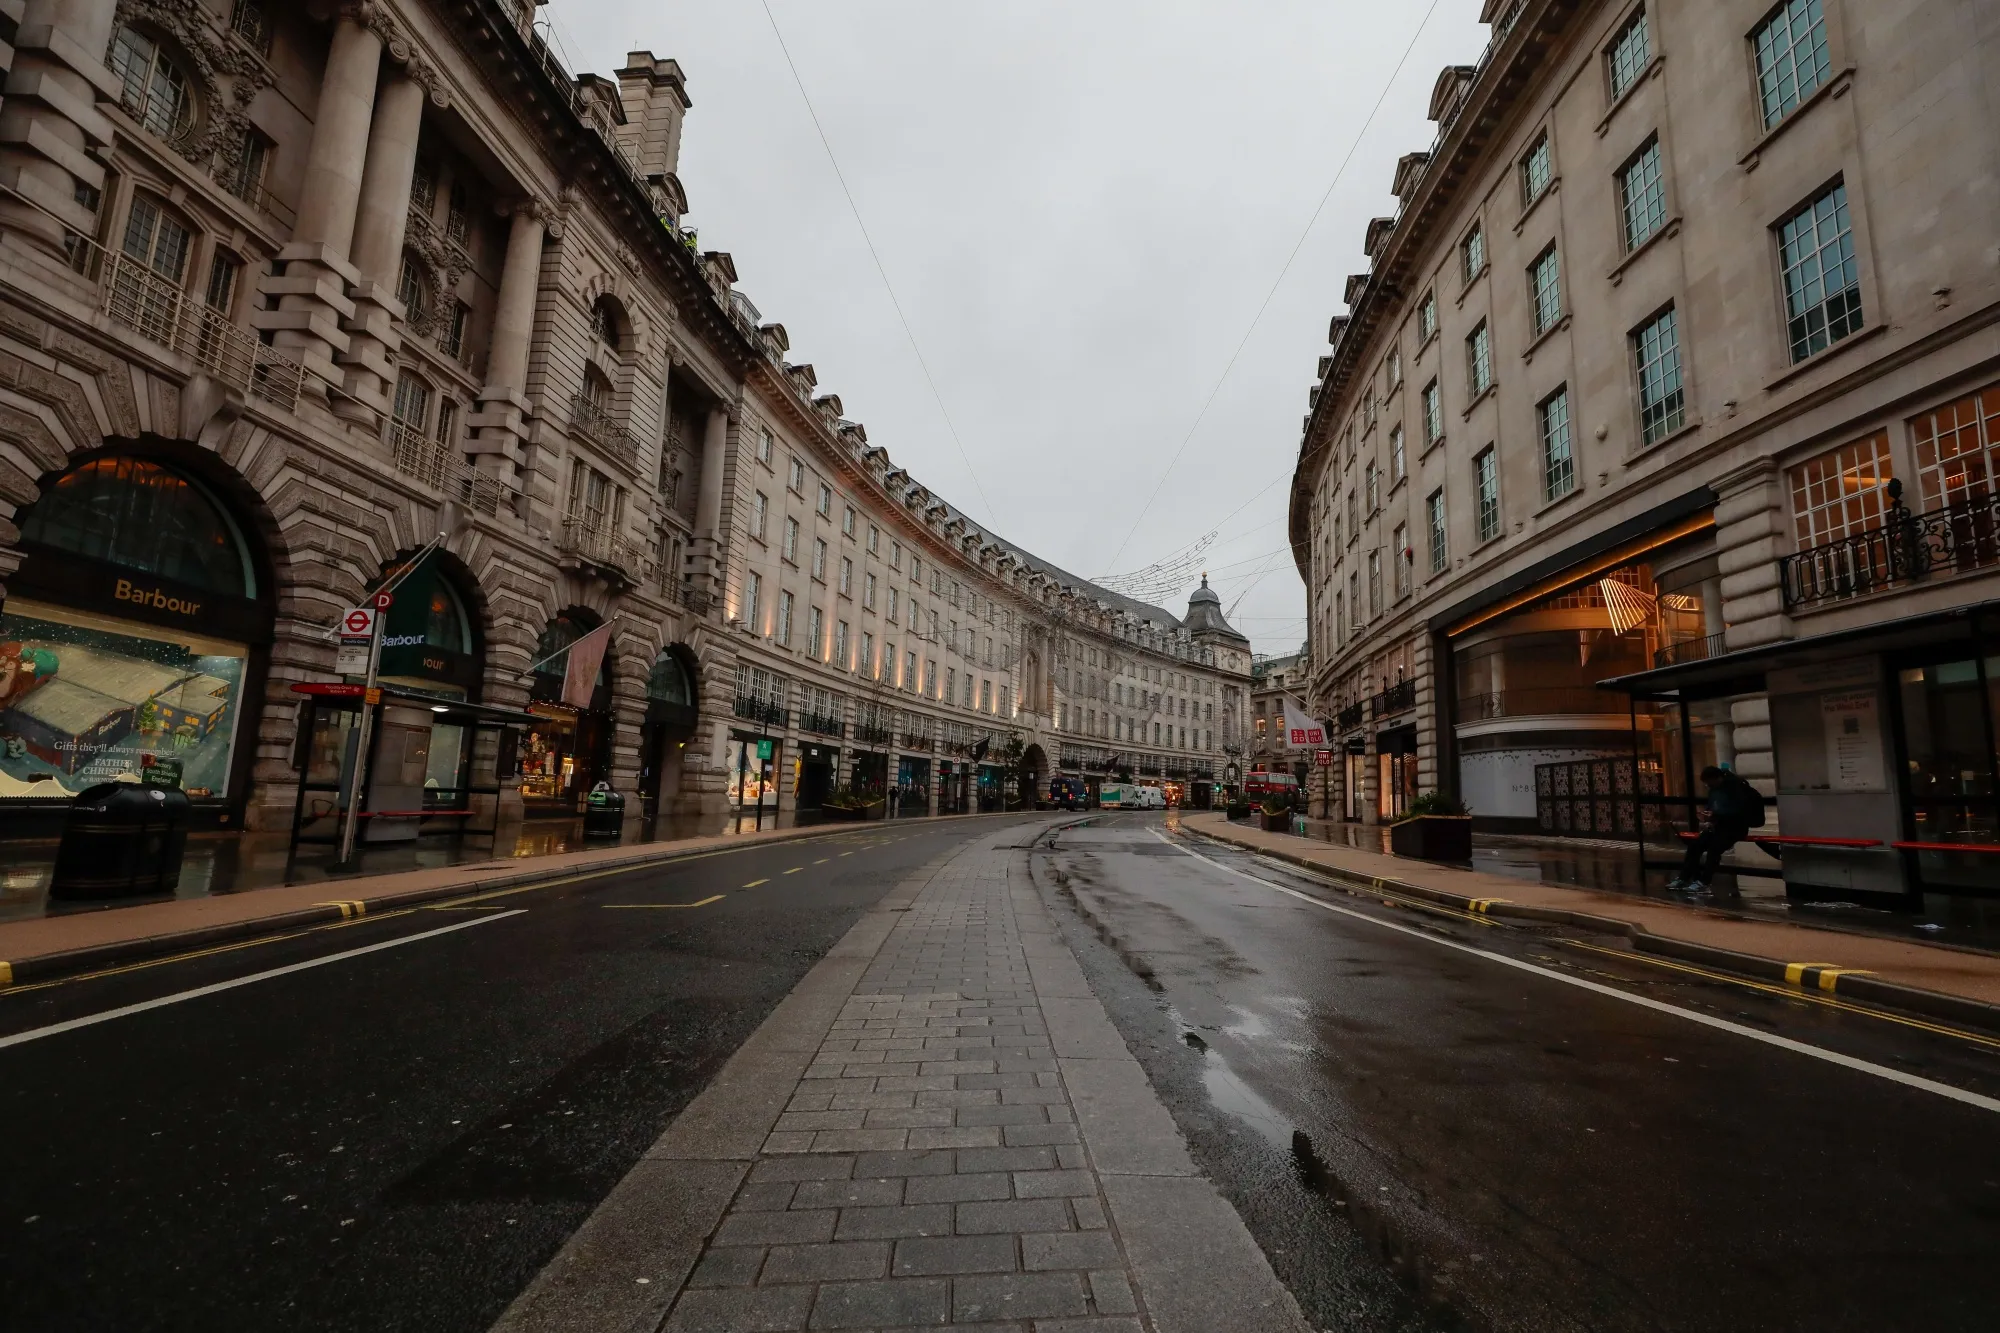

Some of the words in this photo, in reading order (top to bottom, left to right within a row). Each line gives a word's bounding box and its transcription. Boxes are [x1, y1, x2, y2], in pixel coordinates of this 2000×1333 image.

[114, 578, 200, 616] Barbour
[378, 596, 390, 607] D
[381, 634, 424, 647] Barbour
[98, 716, 122, 736] Barbour
[53, 740, 77, 751] Gifts
[79, 742, 107, 754] they'll
[108, 744, 134, 756] always
[95, 758, 133, 768] FATHER
[82, 766, 142, 776] CHRISTMAS
[151, 775, 172, 784] England
